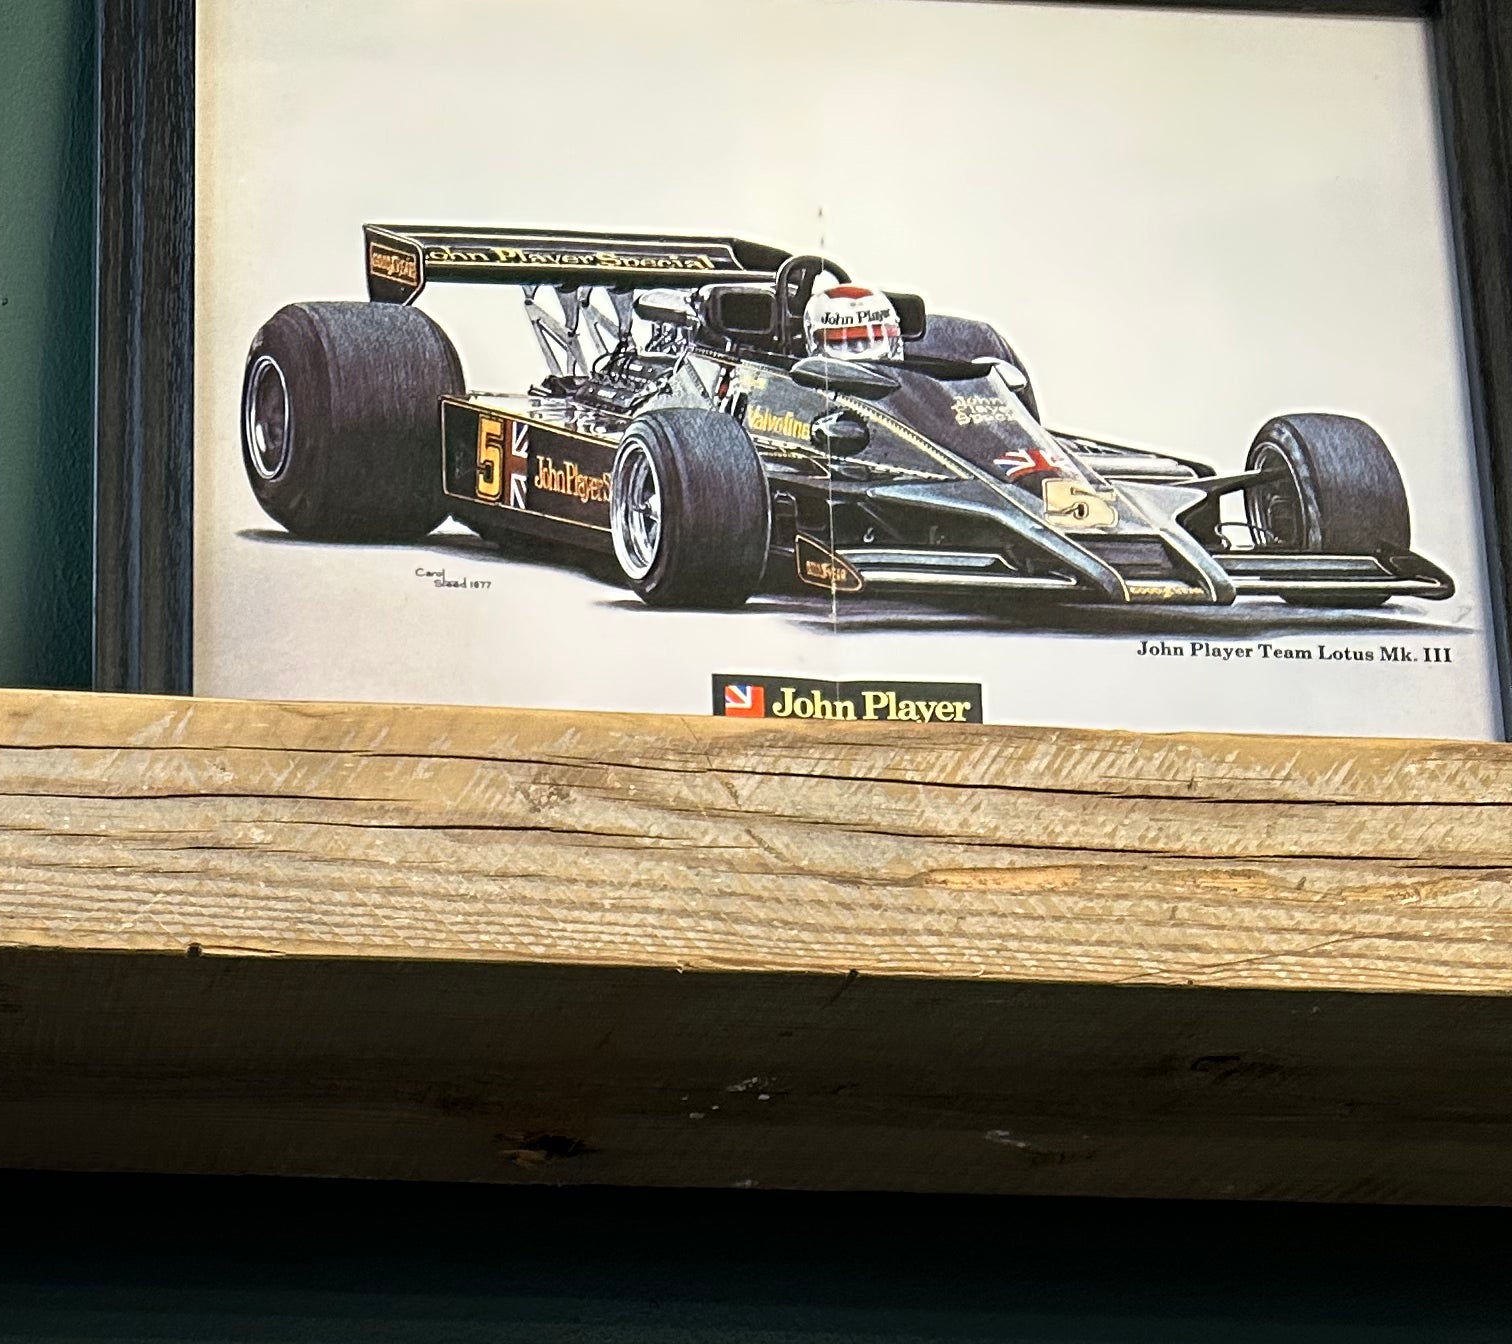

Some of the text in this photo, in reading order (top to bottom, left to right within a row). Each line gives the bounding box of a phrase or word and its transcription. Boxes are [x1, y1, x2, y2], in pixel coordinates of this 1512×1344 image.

[425, 246, 716, 269] ohn Player Special
[821, 312, 853, 325] John
[476, 414, 504, 501] 5
[1042, 478, 1118, 528] 5
[1136, 640, 1452, 663] John Player Team Lotus Mk. III
[772, 687, 971, 723] John Player
